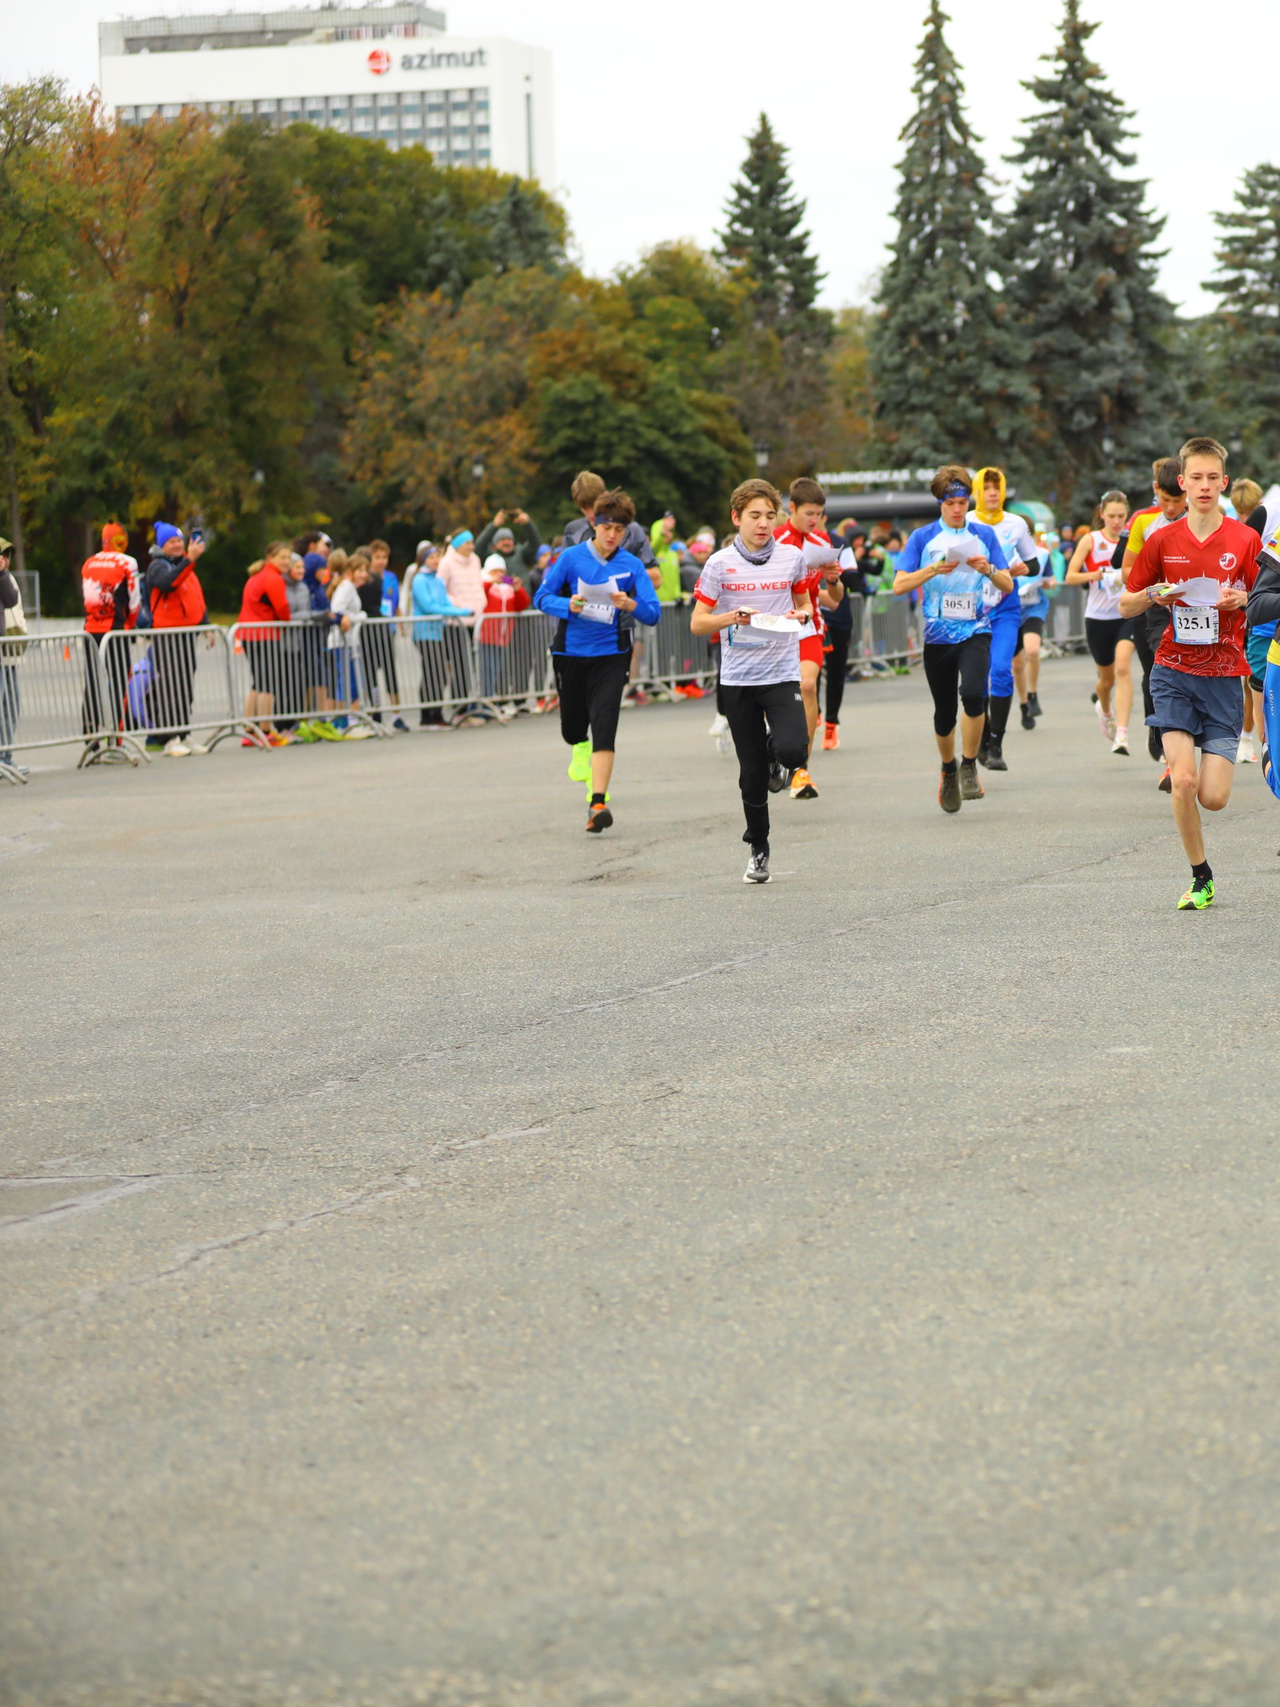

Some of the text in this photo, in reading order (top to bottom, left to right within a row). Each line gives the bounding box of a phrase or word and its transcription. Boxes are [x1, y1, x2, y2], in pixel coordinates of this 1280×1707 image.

[401, 46, 486, 70] azimut
[721, 581, 792, 592] NORD WEST
[943, 600, 972, 610] 305.1
[1177, 617, 1211, 630] 325.1
